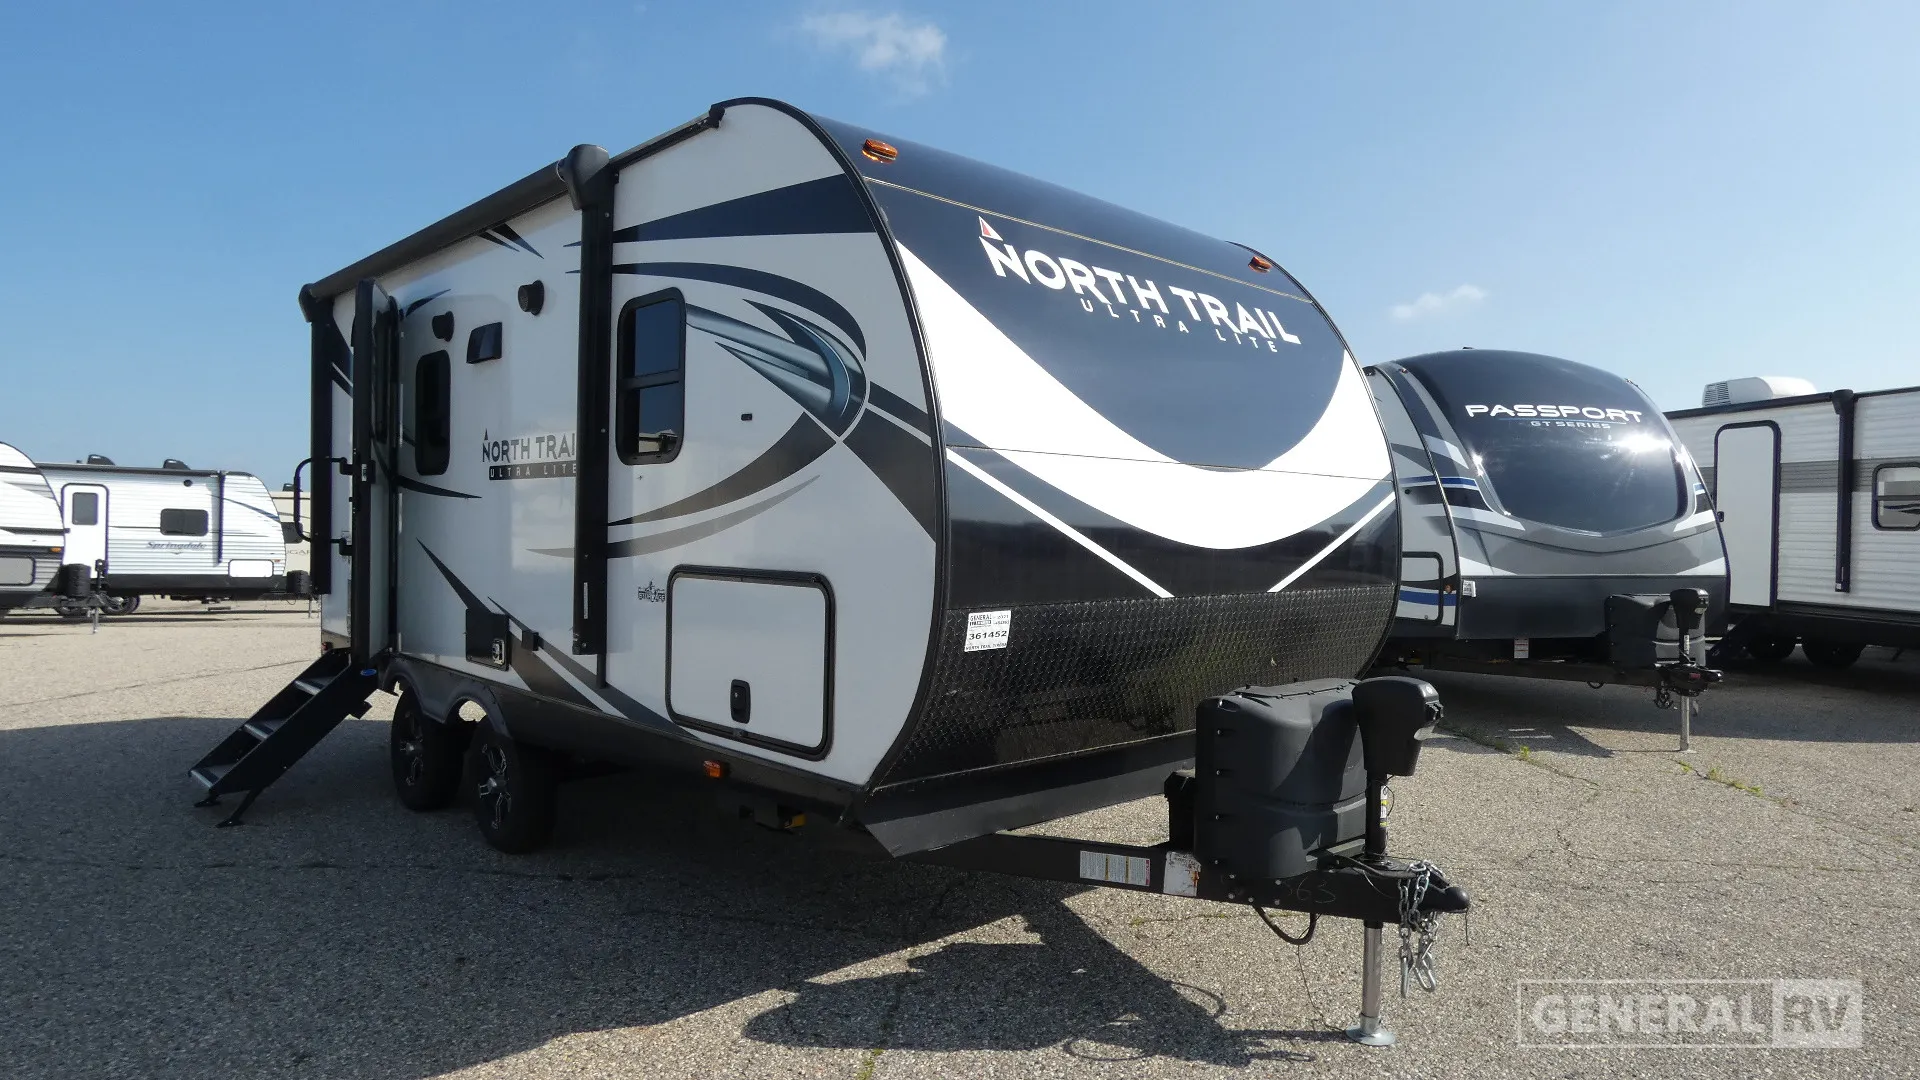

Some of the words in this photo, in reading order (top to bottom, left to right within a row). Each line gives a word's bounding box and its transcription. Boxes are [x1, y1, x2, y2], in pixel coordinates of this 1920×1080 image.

[978, 235, 1170, 314] NORTH
[1168, 285, 1302, 345] TRAIL
[1079, 297, 1190, 334] ULTRA
[1214, 328, 1279, 353] LITE
[1464, 404, 1643, 423] PASSPORT
[1530, 420, 1551, 428] GT
[1555, 420, 1612, 430] SERIES
[482, 438, 531, 463] NORTH
[535, 433, 576, 460] TRAI
[490, 465, 531, 478] ULTRA
[543, 463, 577, 475] LITE
[146, 541, 207, 551] Springdale
[969, 630, 1007, 640] 361452
